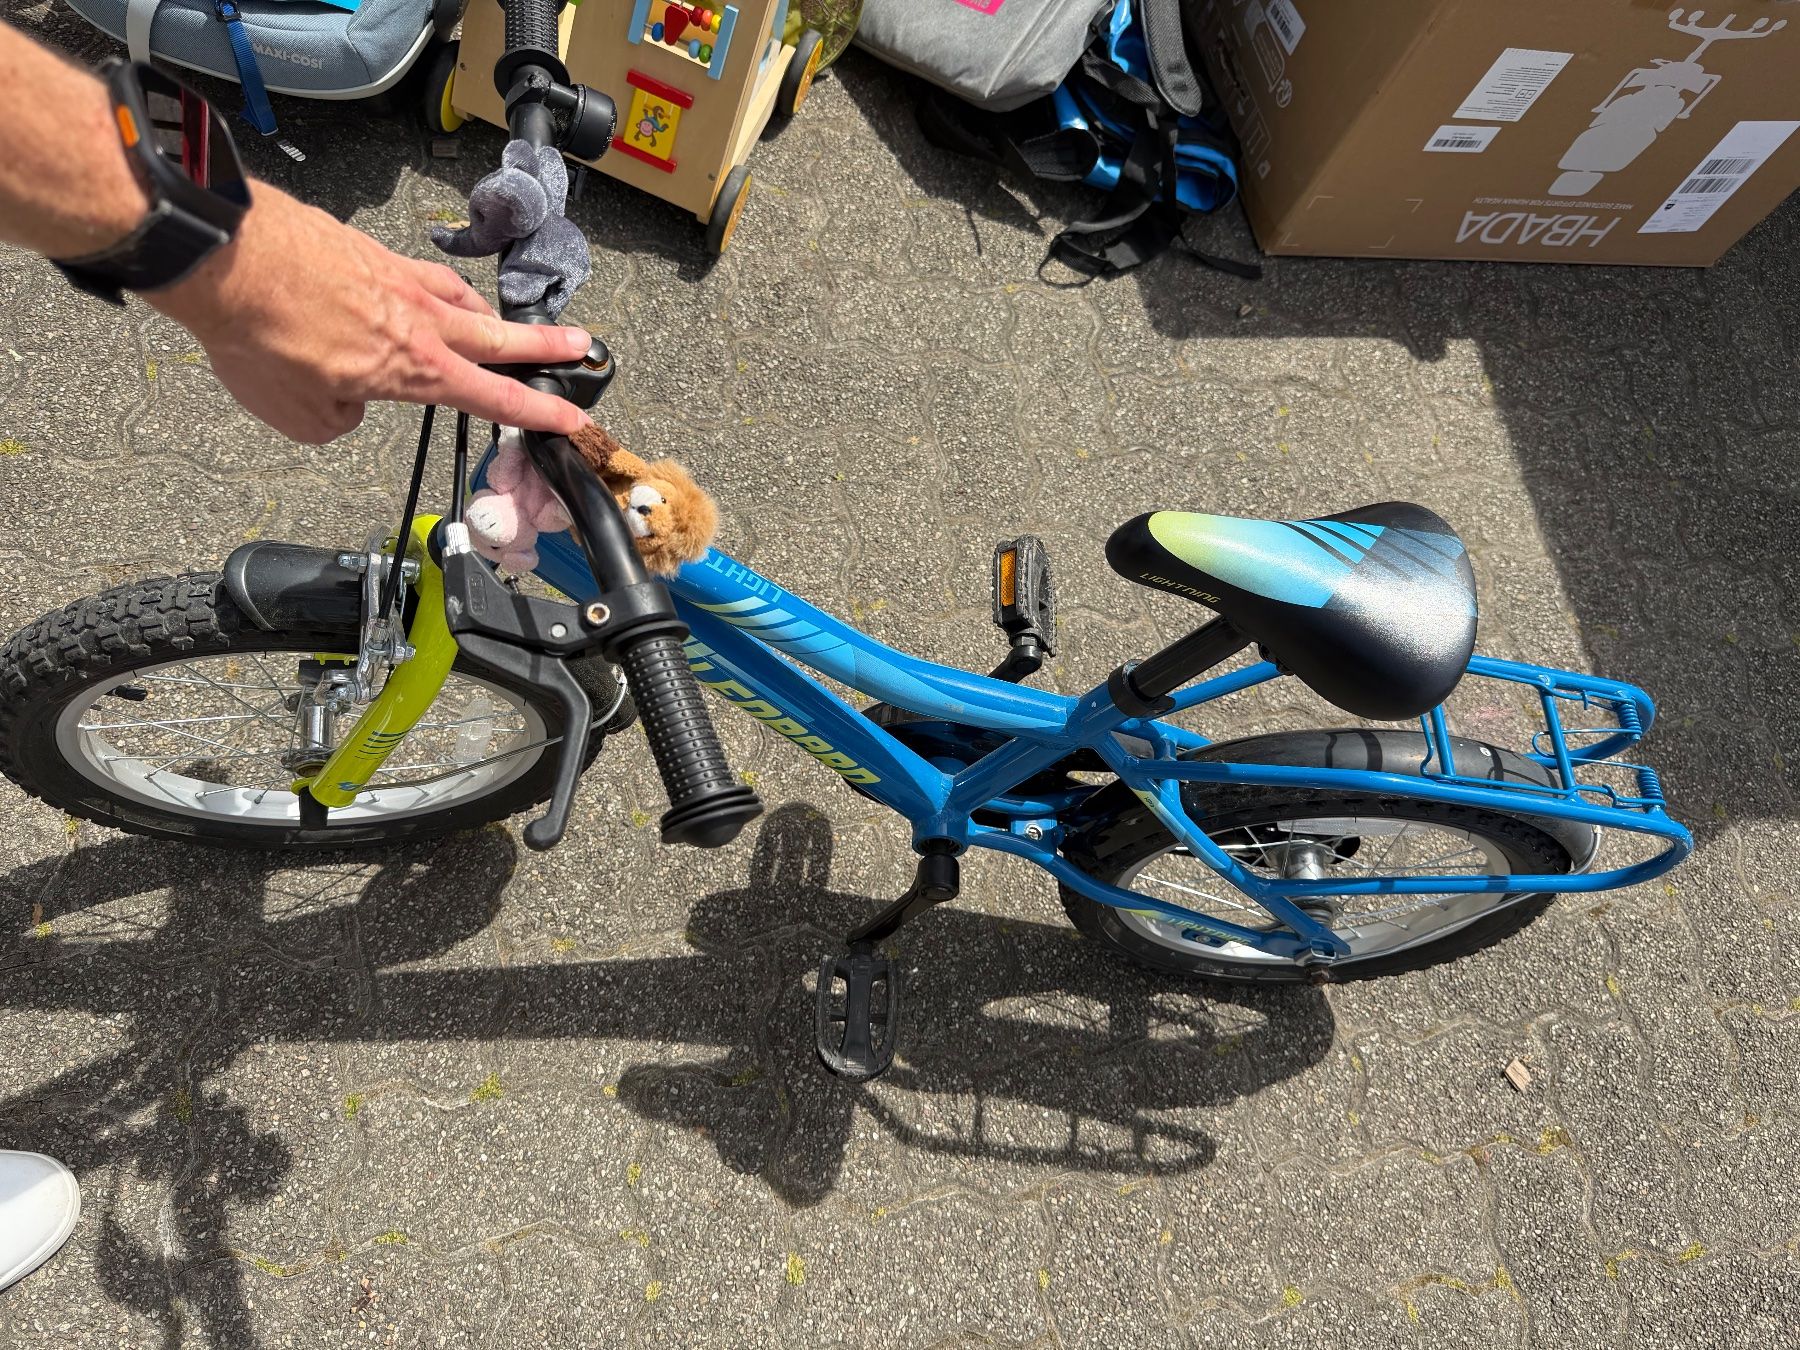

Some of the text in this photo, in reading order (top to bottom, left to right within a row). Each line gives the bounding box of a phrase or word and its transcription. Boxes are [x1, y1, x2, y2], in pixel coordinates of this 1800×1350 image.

[252, 43, 323, 69] MAXI-COSI
[1456, 212, 1621, 247] HBADA
[704, 548, 783, 603] LIGHT
[1139, 572, 1221, 604] LIGHTNING
